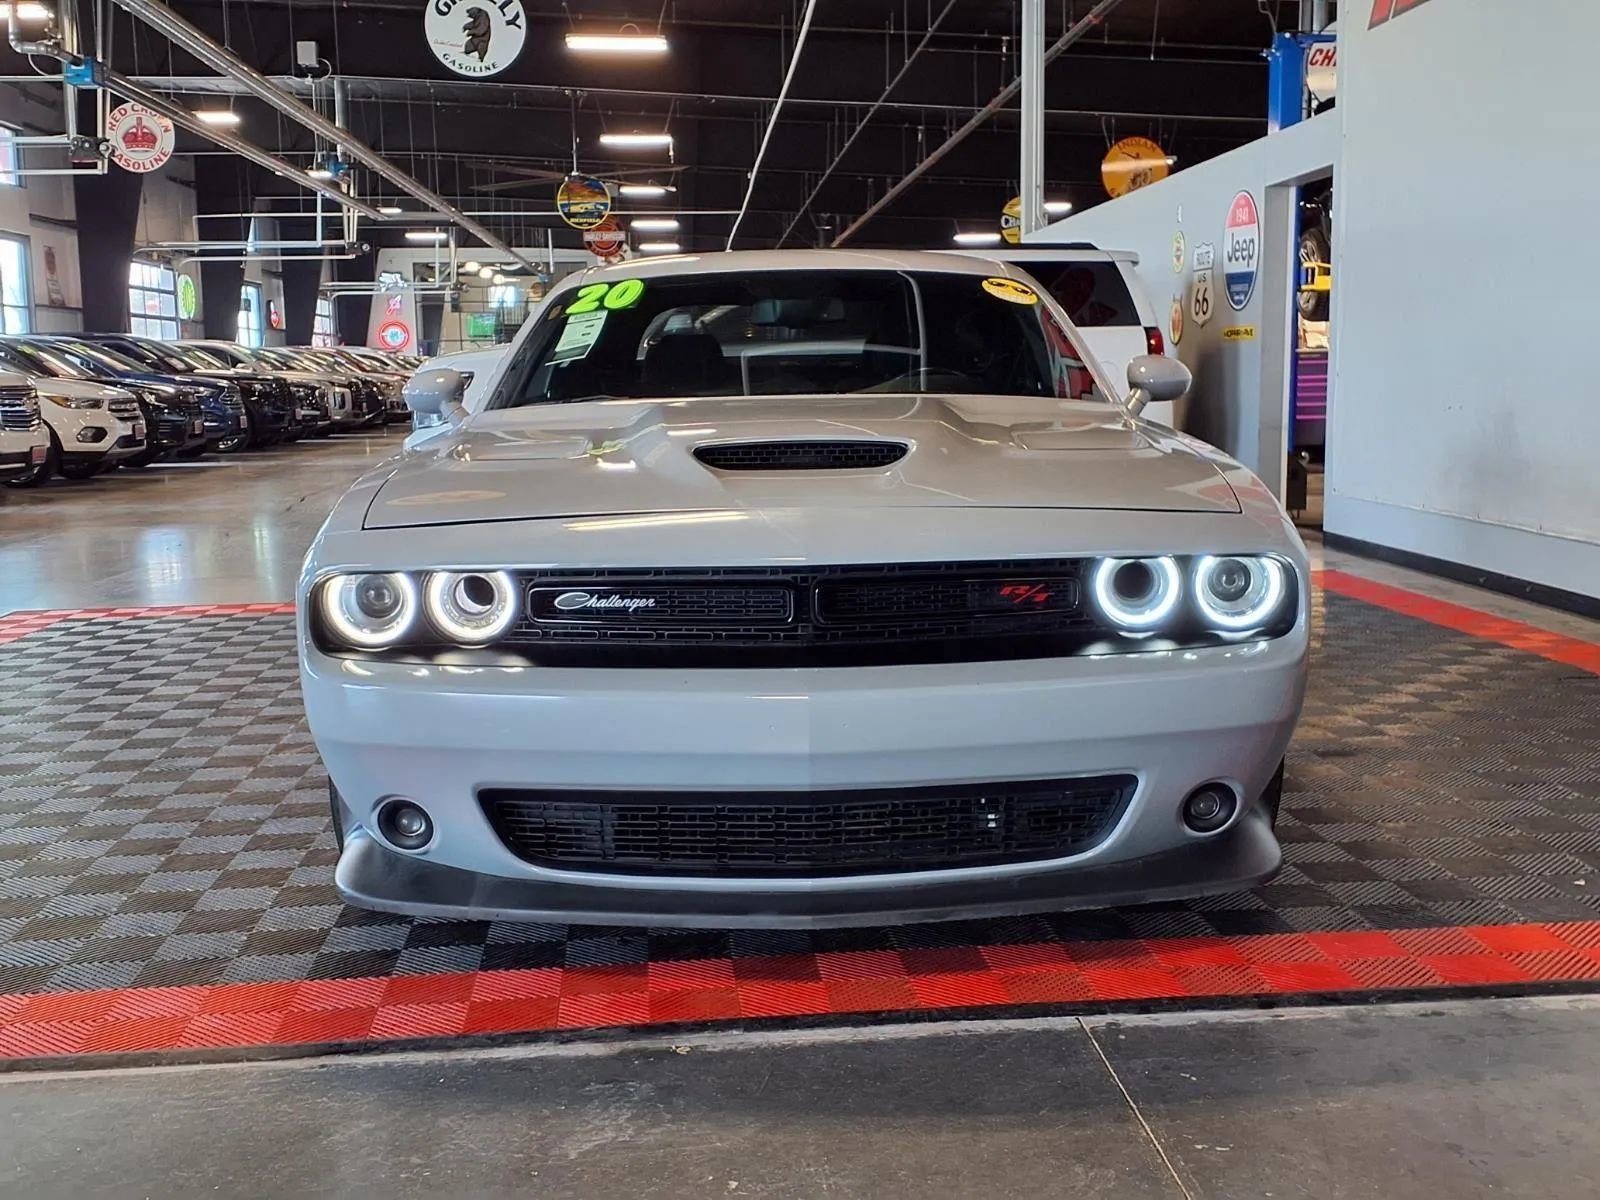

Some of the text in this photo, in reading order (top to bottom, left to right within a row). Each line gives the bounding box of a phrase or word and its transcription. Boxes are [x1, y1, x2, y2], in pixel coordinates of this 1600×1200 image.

[442, 53, 499, 73] GASOLINE
[1309, 46, 1336, 67] CH
[108, 107, 128, 132] RED
[1227, 232, 1255, 268] Jeep
[565, 279, 645, 315] 20
[1194, 287, 1209, 316] 66
[553, 591, 656, 612] Challenger
[1000, 584, 1056, 603] R/T
